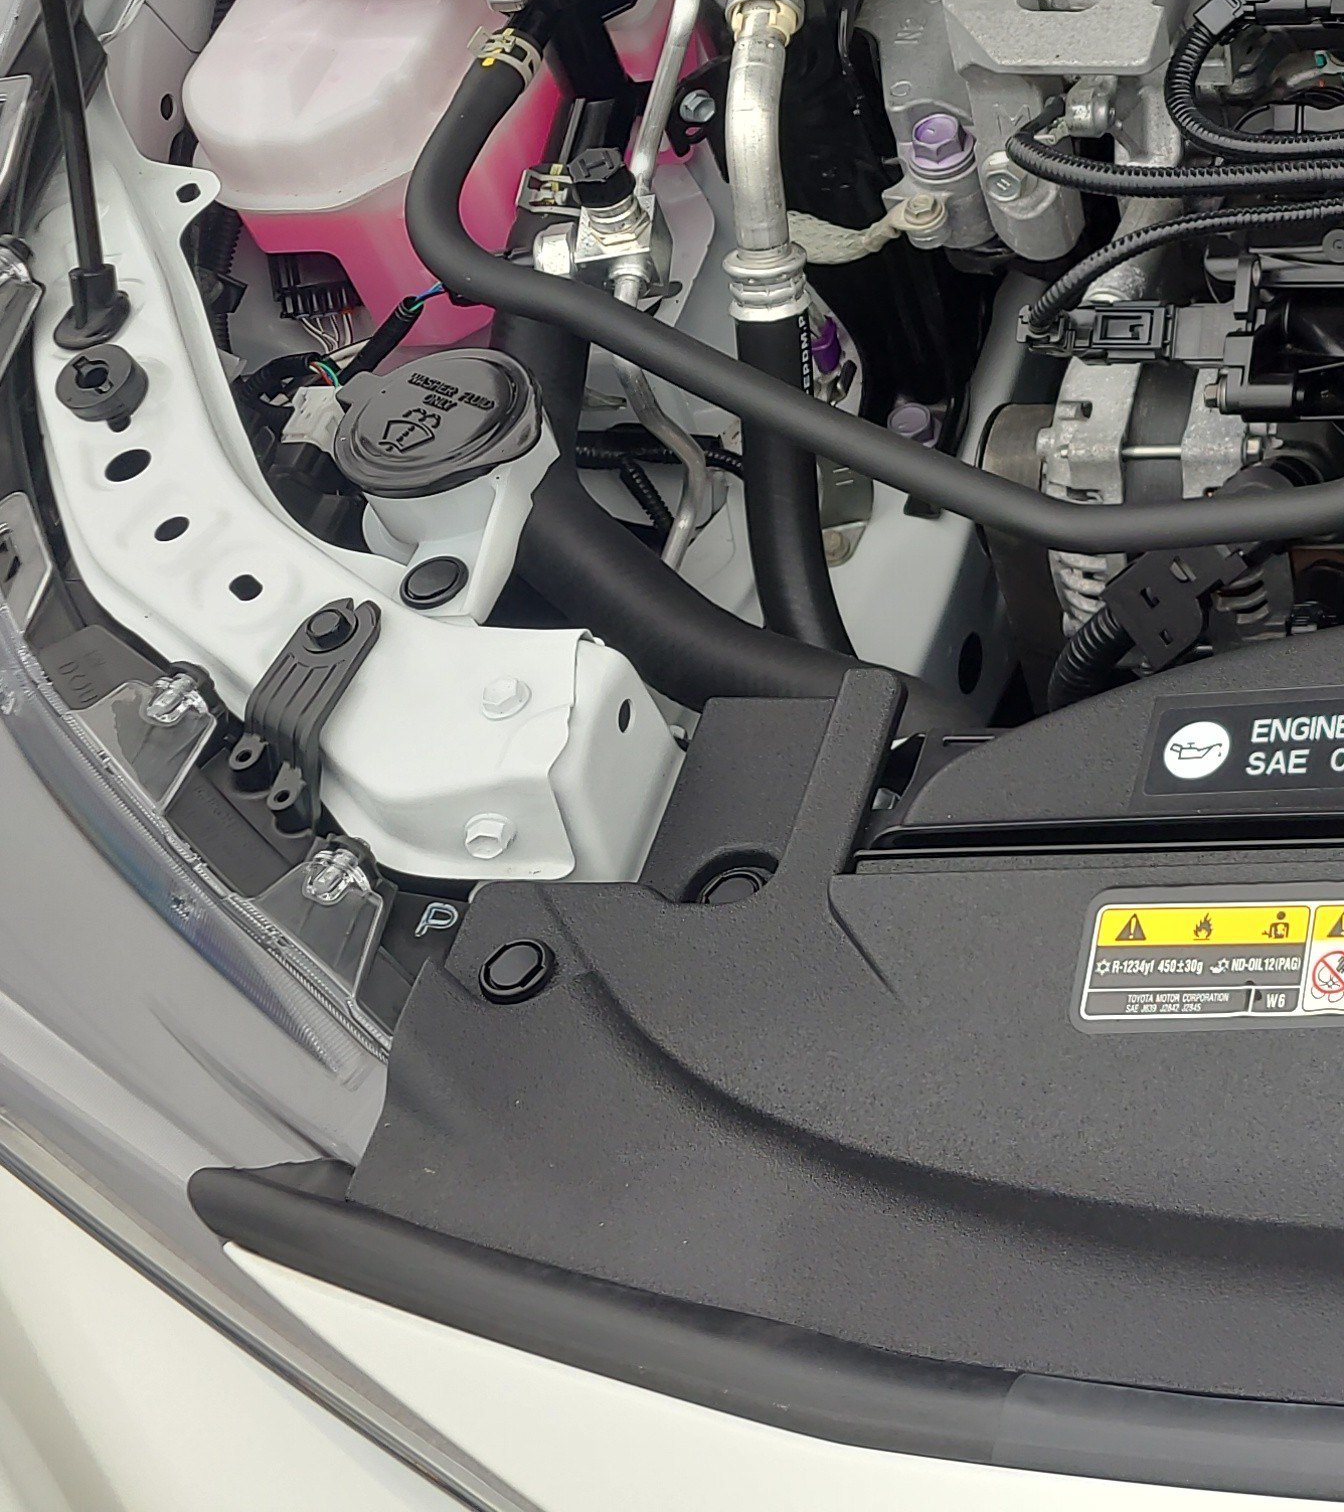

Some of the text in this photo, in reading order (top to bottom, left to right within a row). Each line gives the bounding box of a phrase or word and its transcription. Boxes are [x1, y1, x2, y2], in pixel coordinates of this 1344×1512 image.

[407, 372, 495, 411] WASHER FLUID
[422, 393, 458, 412] ONLY
[1245, 748, 1311, 776] SAE
[414, 901, 459, 937] P
[1128, 992, 1230, 1004] TOYOTA MOTOR CORPORATION
[1266, 992, 1290, 1009] W6
[1126, 1004, 1140, 1013] SAE
